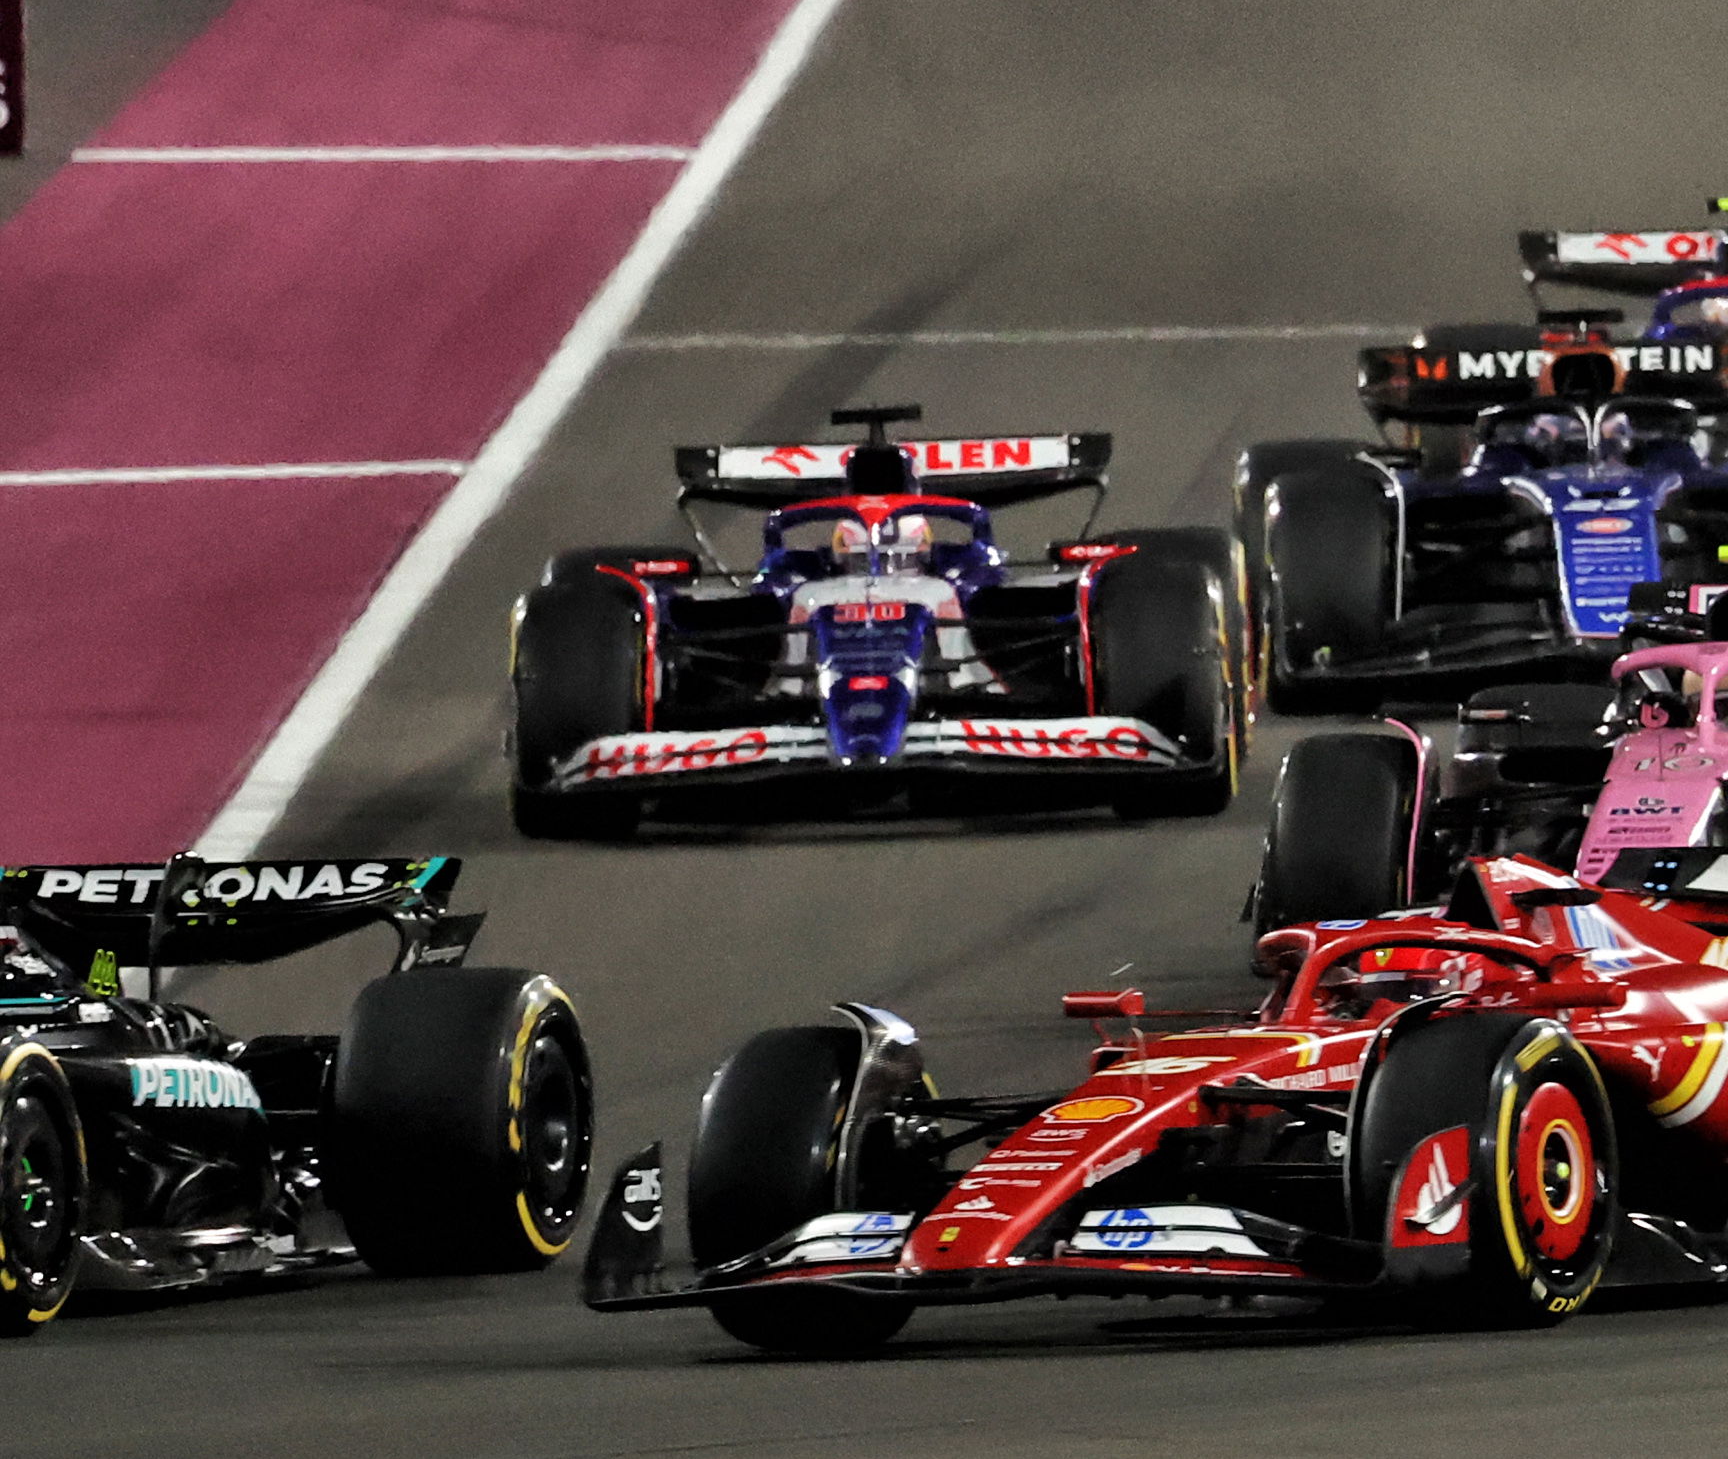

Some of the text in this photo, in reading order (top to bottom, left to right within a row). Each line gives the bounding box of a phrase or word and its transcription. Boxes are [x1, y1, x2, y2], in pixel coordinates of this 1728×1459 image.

[584, 729, 768, 781] HUGO
[961, 719, 1151, 761] HUGO
[37, 864, 390, 906] PETONAS
